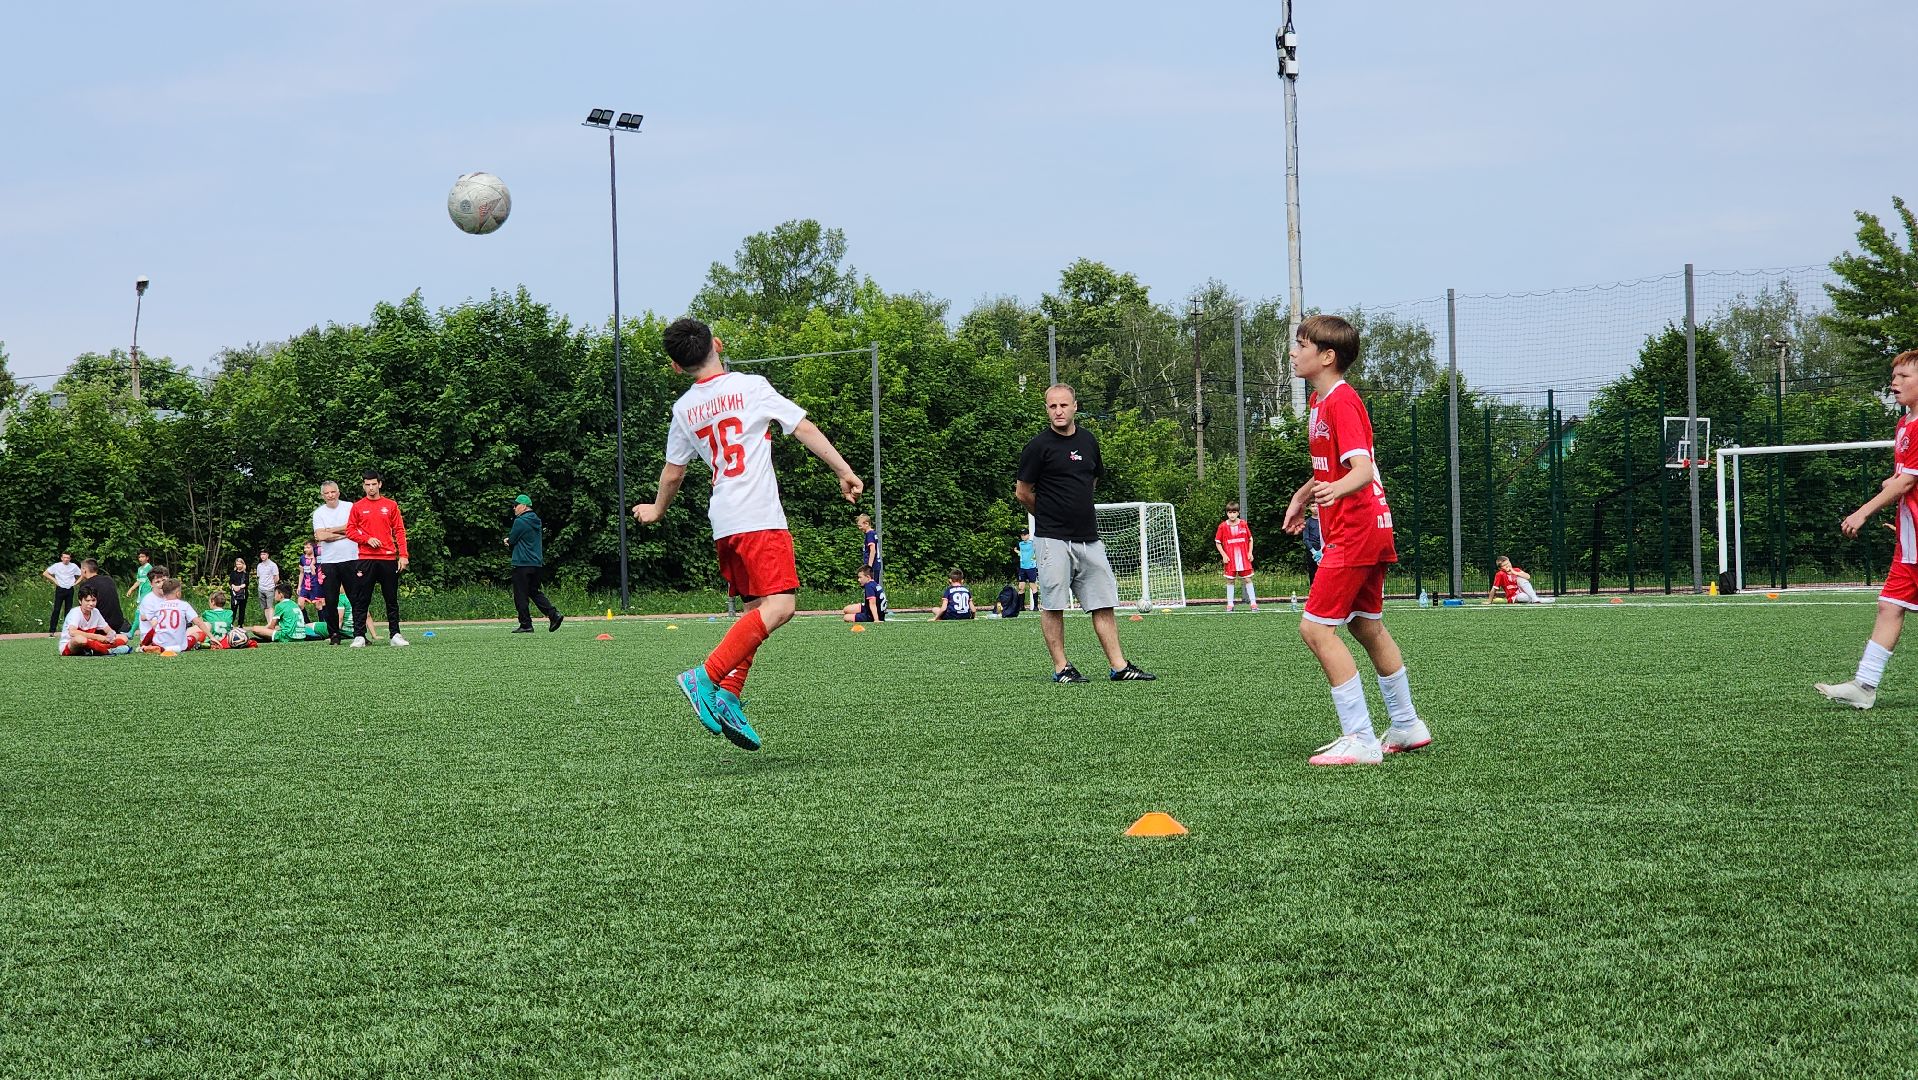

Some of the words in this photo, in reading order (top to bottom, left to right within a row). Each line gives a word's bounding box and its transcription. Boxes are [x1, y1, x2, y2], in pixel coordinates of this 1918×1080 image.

[687, 393, 744, 426] КУКУШКИН
[694, 416, 746, 486] 76
[952, 592, 970, 613] 90
[159, 609, 180, 630] 20
